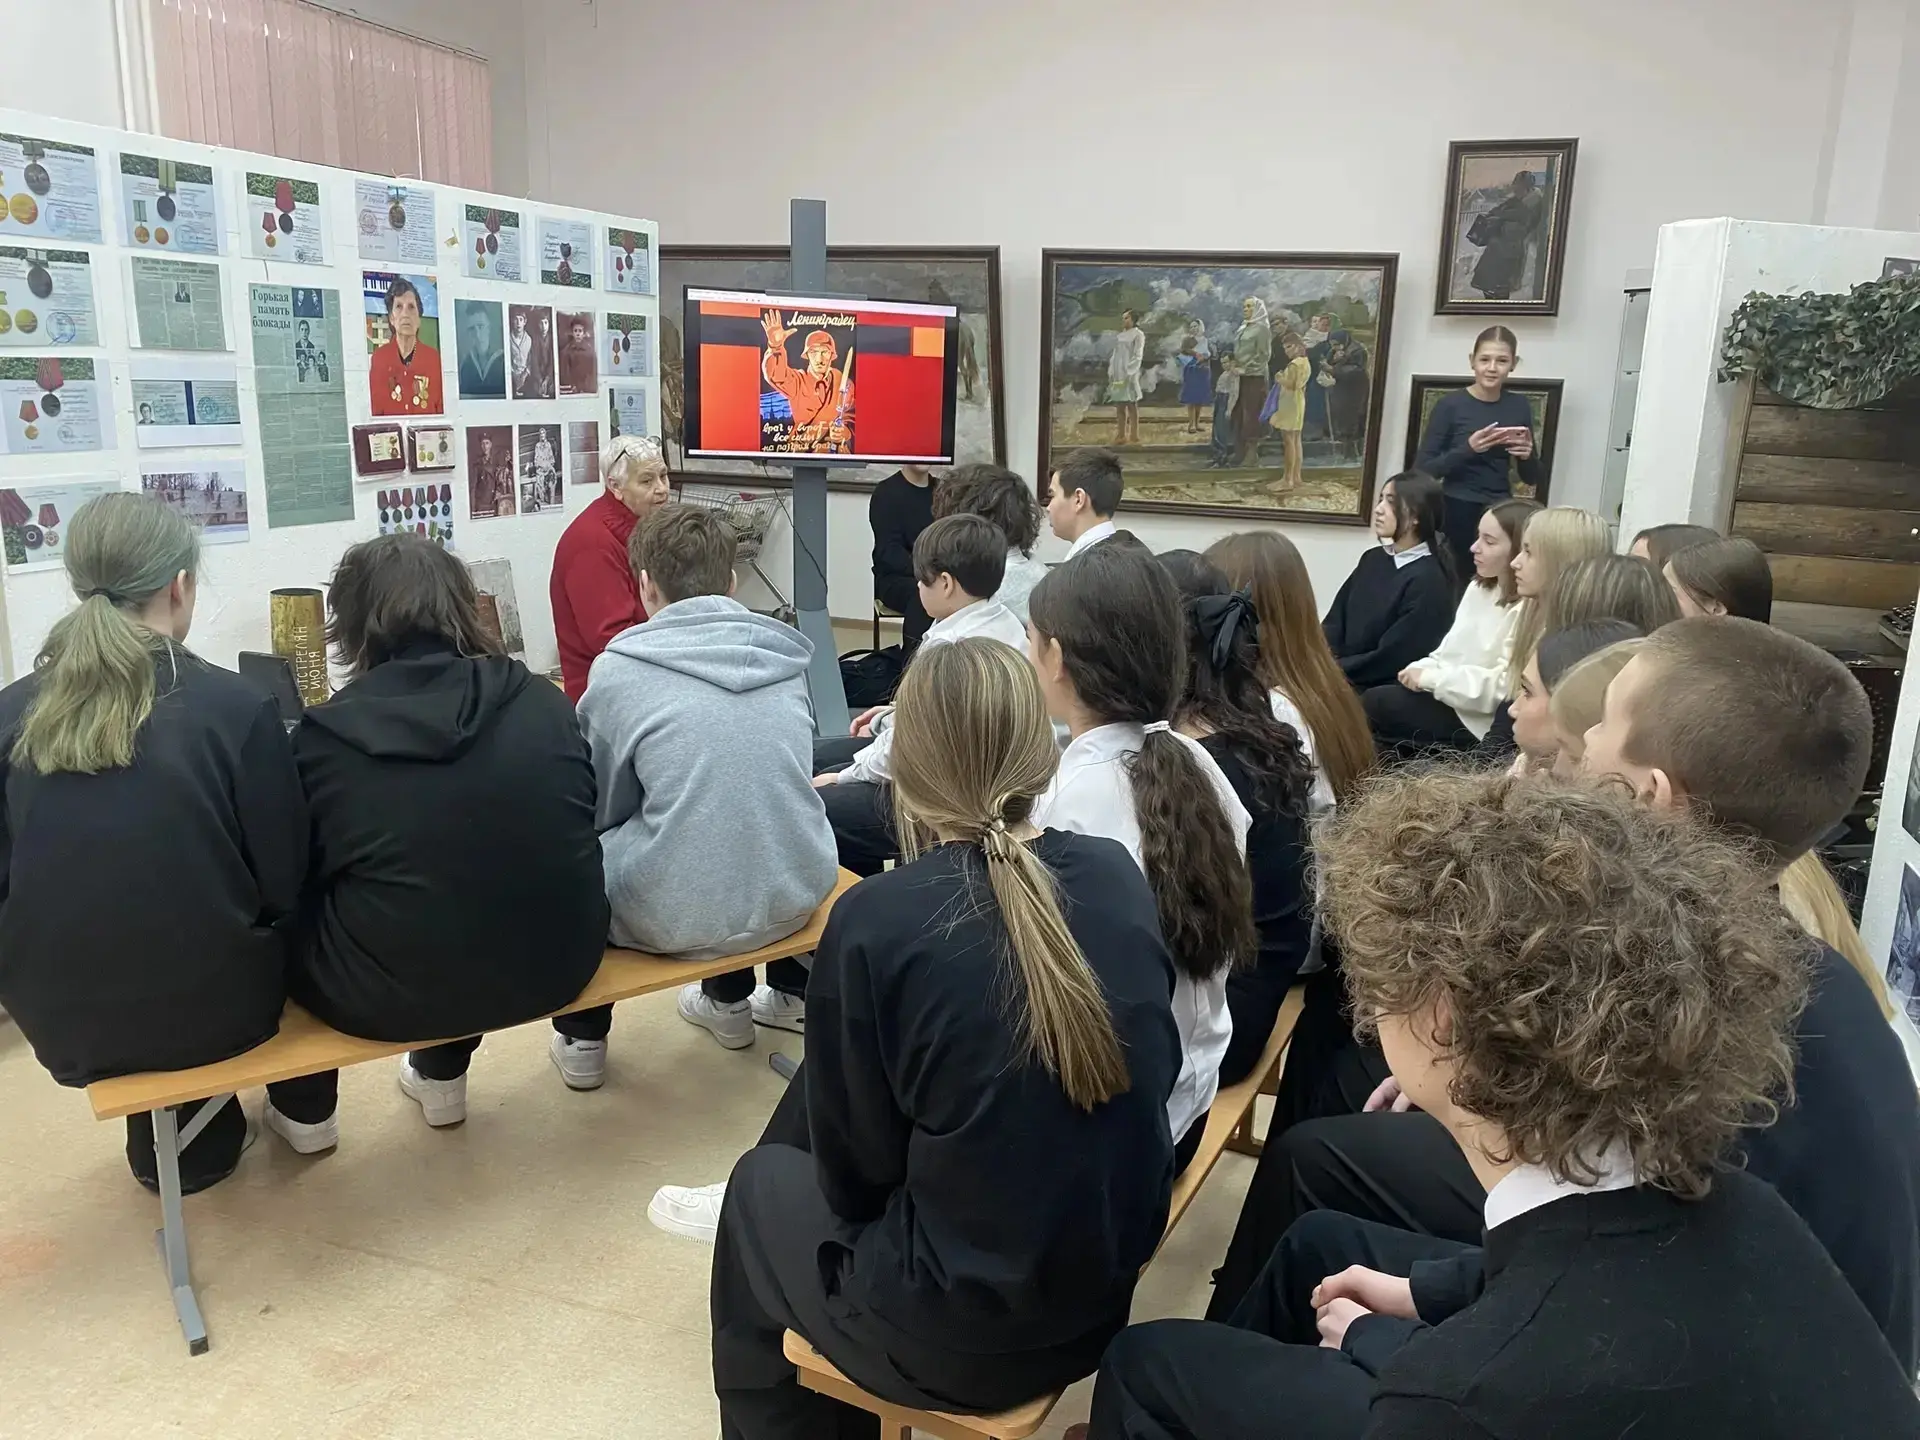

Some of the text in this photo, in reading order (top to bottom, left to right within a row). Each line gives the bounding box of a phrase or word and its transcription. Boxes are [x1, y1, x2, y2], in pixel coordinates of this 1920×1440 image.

[252, 289, 289, 303] Горькая
[257, 306, 290, 315] память
[252, 316, 291, 329] блокады
[787, 311, 857, 331] Ленинградец
[309, 651, 321, 690] ИЮНЯ
